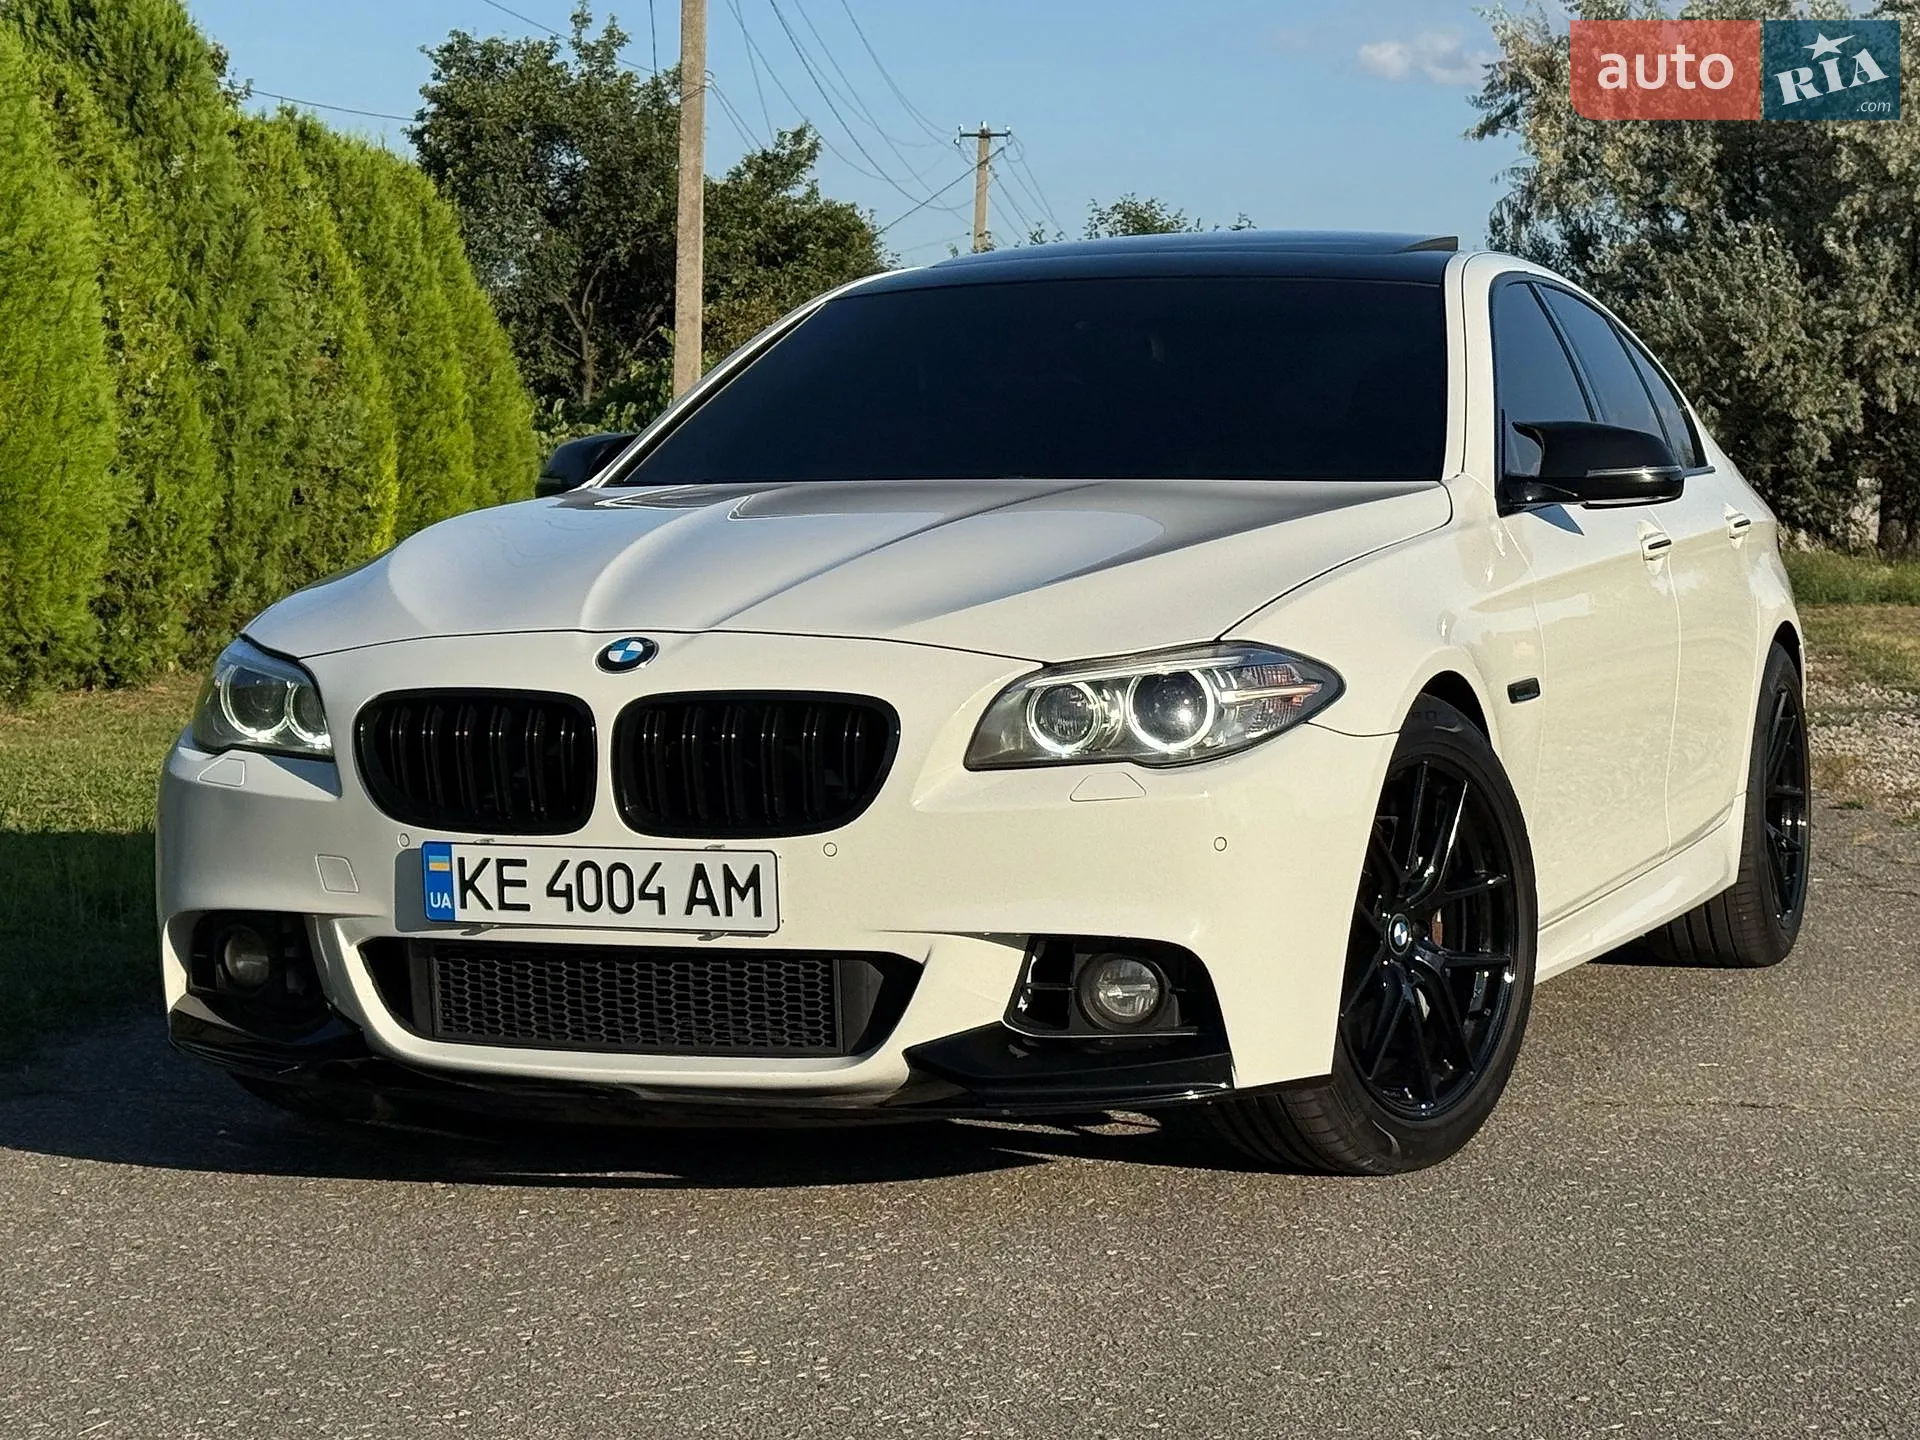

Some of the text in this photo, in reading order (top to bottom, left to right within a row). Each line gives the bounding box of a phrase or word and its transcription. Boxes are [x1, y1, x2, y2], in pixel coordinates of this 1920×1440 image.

[430, 891, 452, 909] UA
[457, 856, 762, 918] KE 4004 AM
